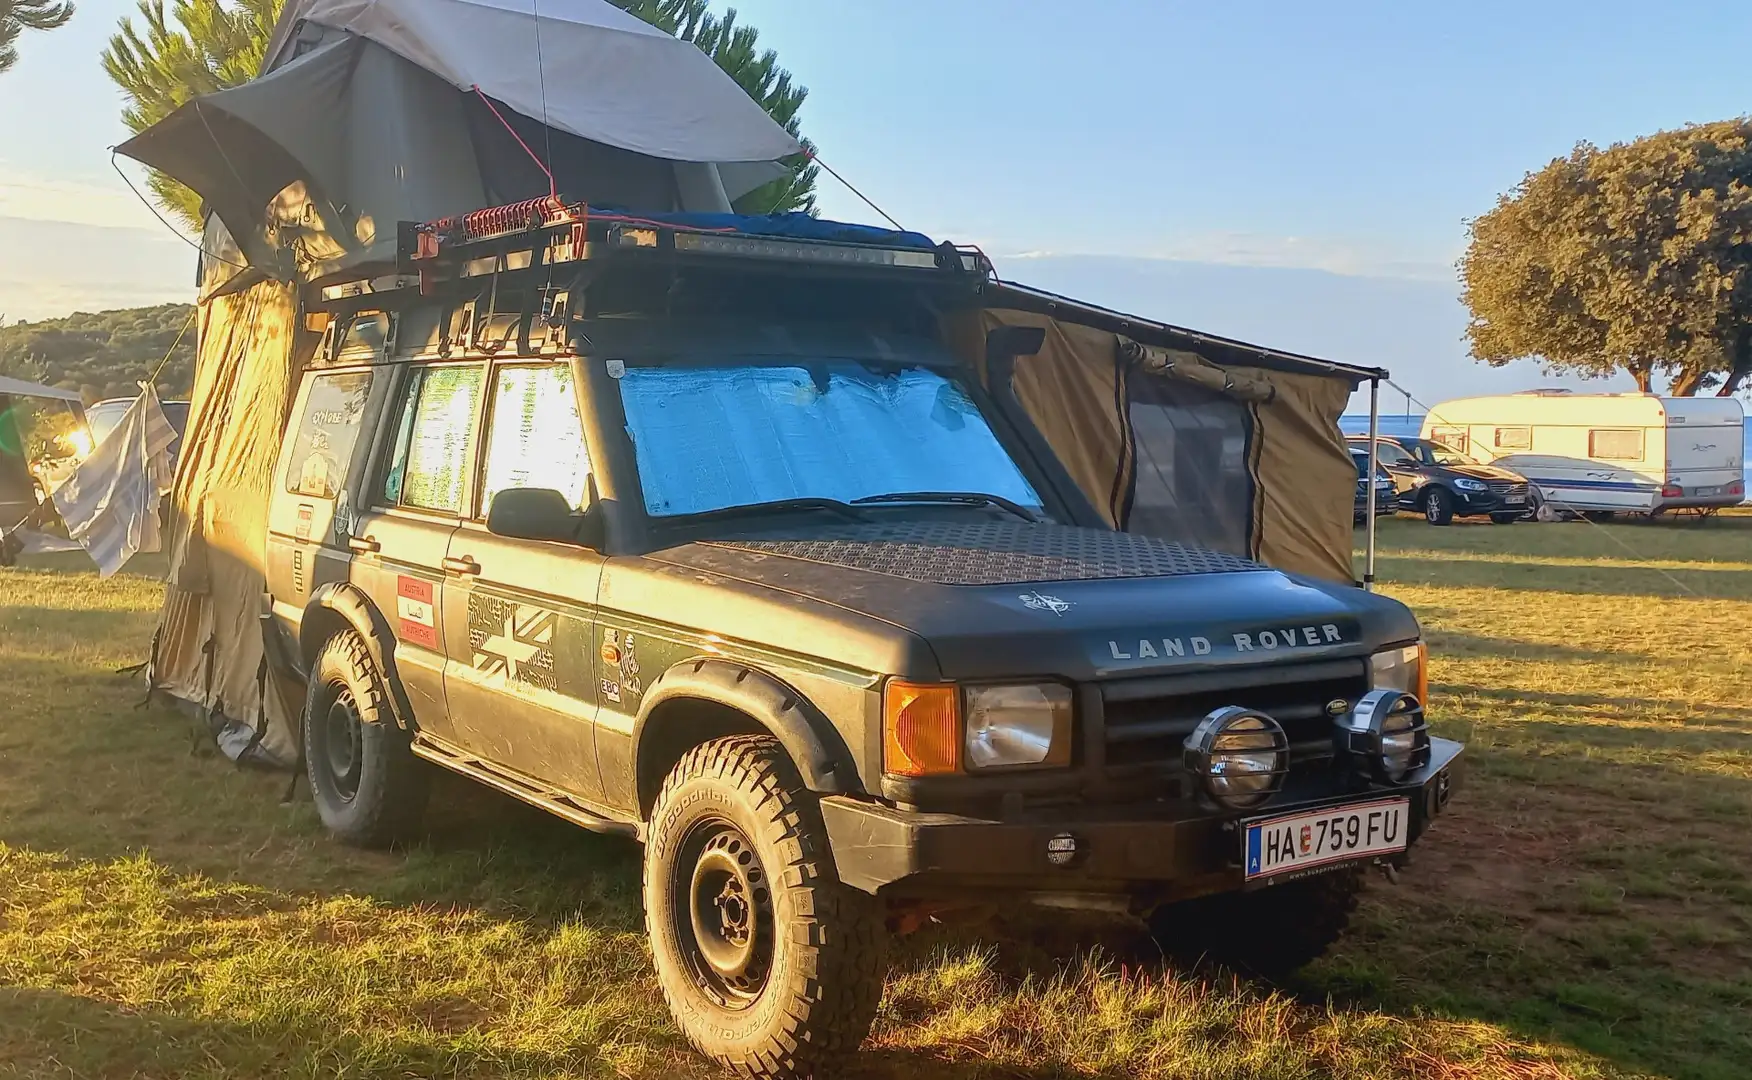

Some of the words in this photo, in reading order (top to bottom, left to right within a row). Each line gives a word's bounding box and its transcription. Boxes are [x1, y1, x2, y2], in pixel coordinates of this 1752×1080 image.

[1108, 636, 1212, 659] LAND
[1232, 623, 1342, 652] ROVER
[601, 680, 618, 695] EBC
[1267, 827, 1296, 866] HA
[1315, 815, 1360, 855] 759
[1366, 809, 1399, 846] FU
[1251, 857, 1258, 869] A
